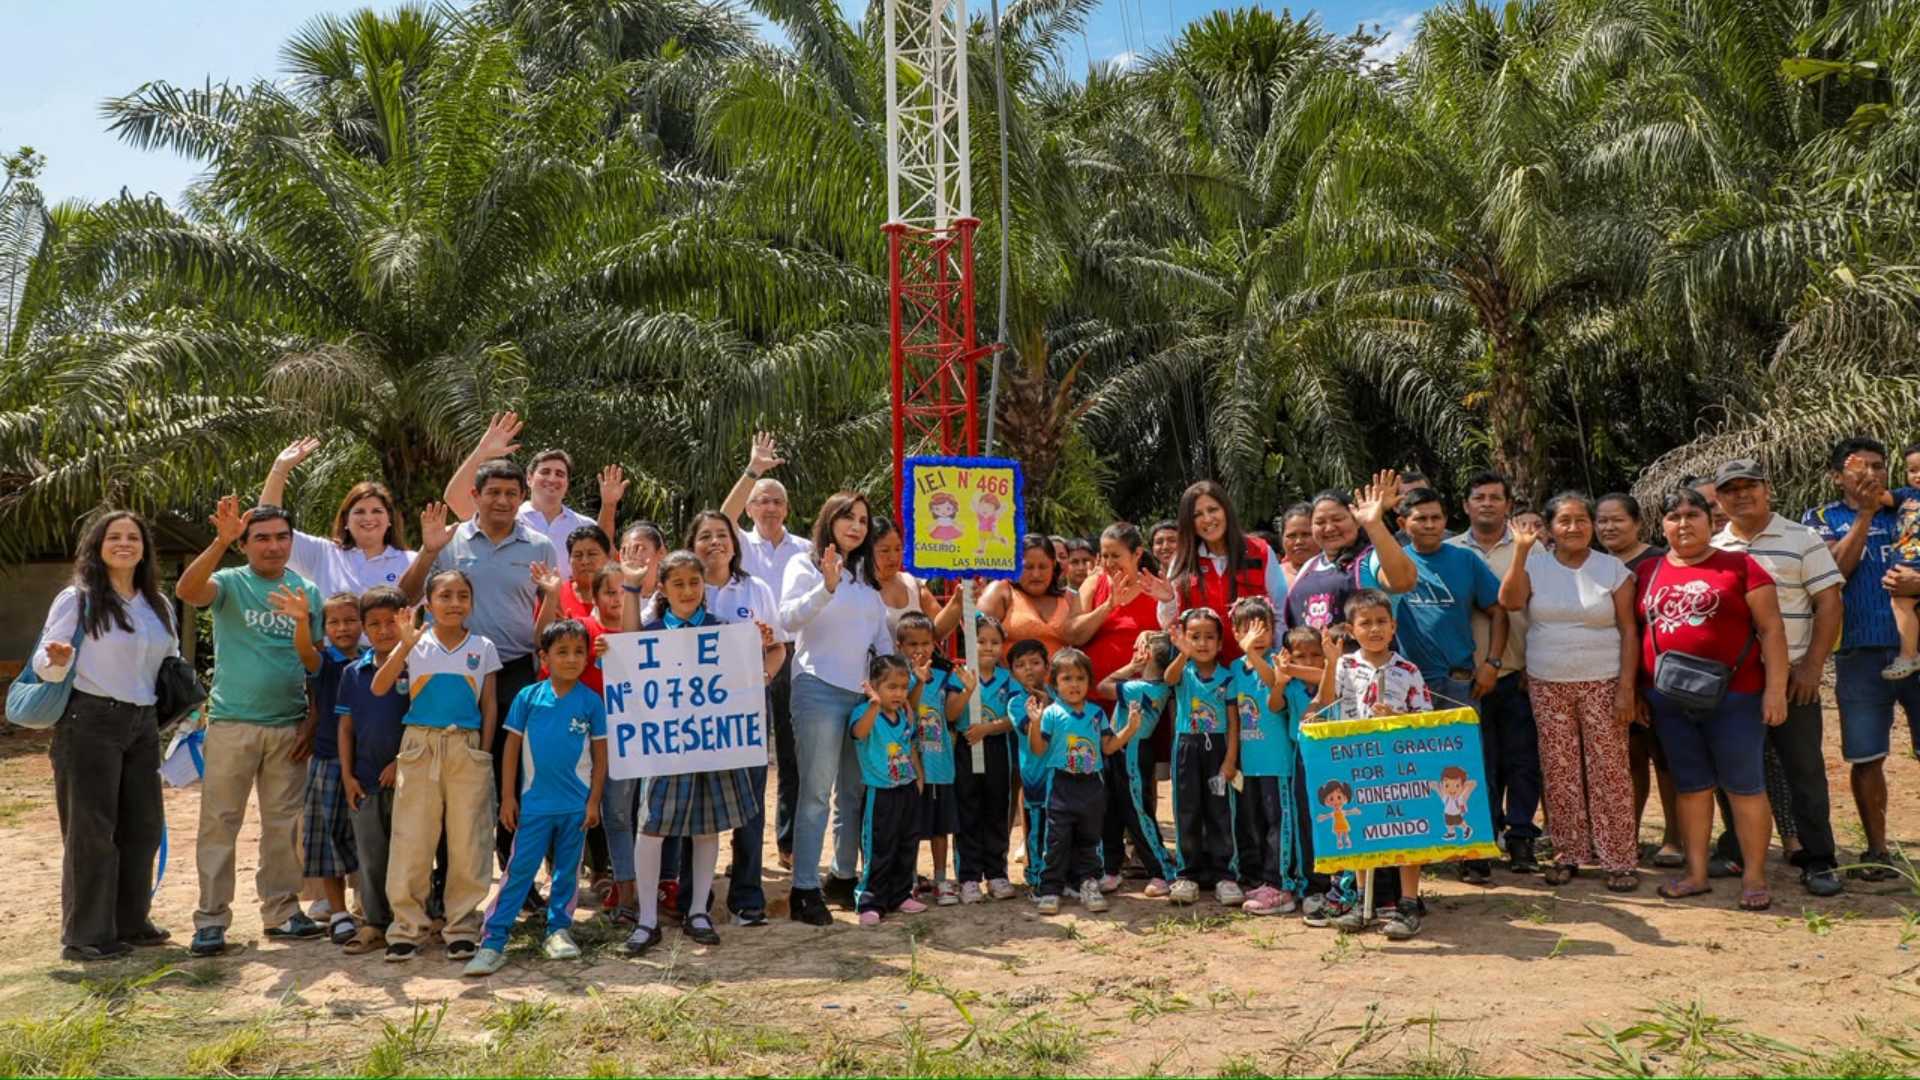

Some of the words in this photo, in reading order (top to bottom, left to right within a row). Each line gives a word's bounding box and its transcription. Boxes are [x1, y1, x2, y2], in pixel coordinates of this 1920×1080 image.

[976, 475, 1008, 496] 466
[952, 558, 969, 567] LAS
[974, 558, 1013, 568] PALMAS
[643, 674, 728, 710] 0786
[616, 712, 763, 758] PRESENTE
[1330, 741, 1384, 762] ENTEL
[1393, 735, 1464, 754] GRACIAS
[1351, 764, 1385, 781] POR
[1398, 761, 1417, 776] LA
[1355, 780, 1432, 804] CONECCION
[1385, 804, 1404, 818] AL
[1363, 818, 1429, 840] MUNDO
